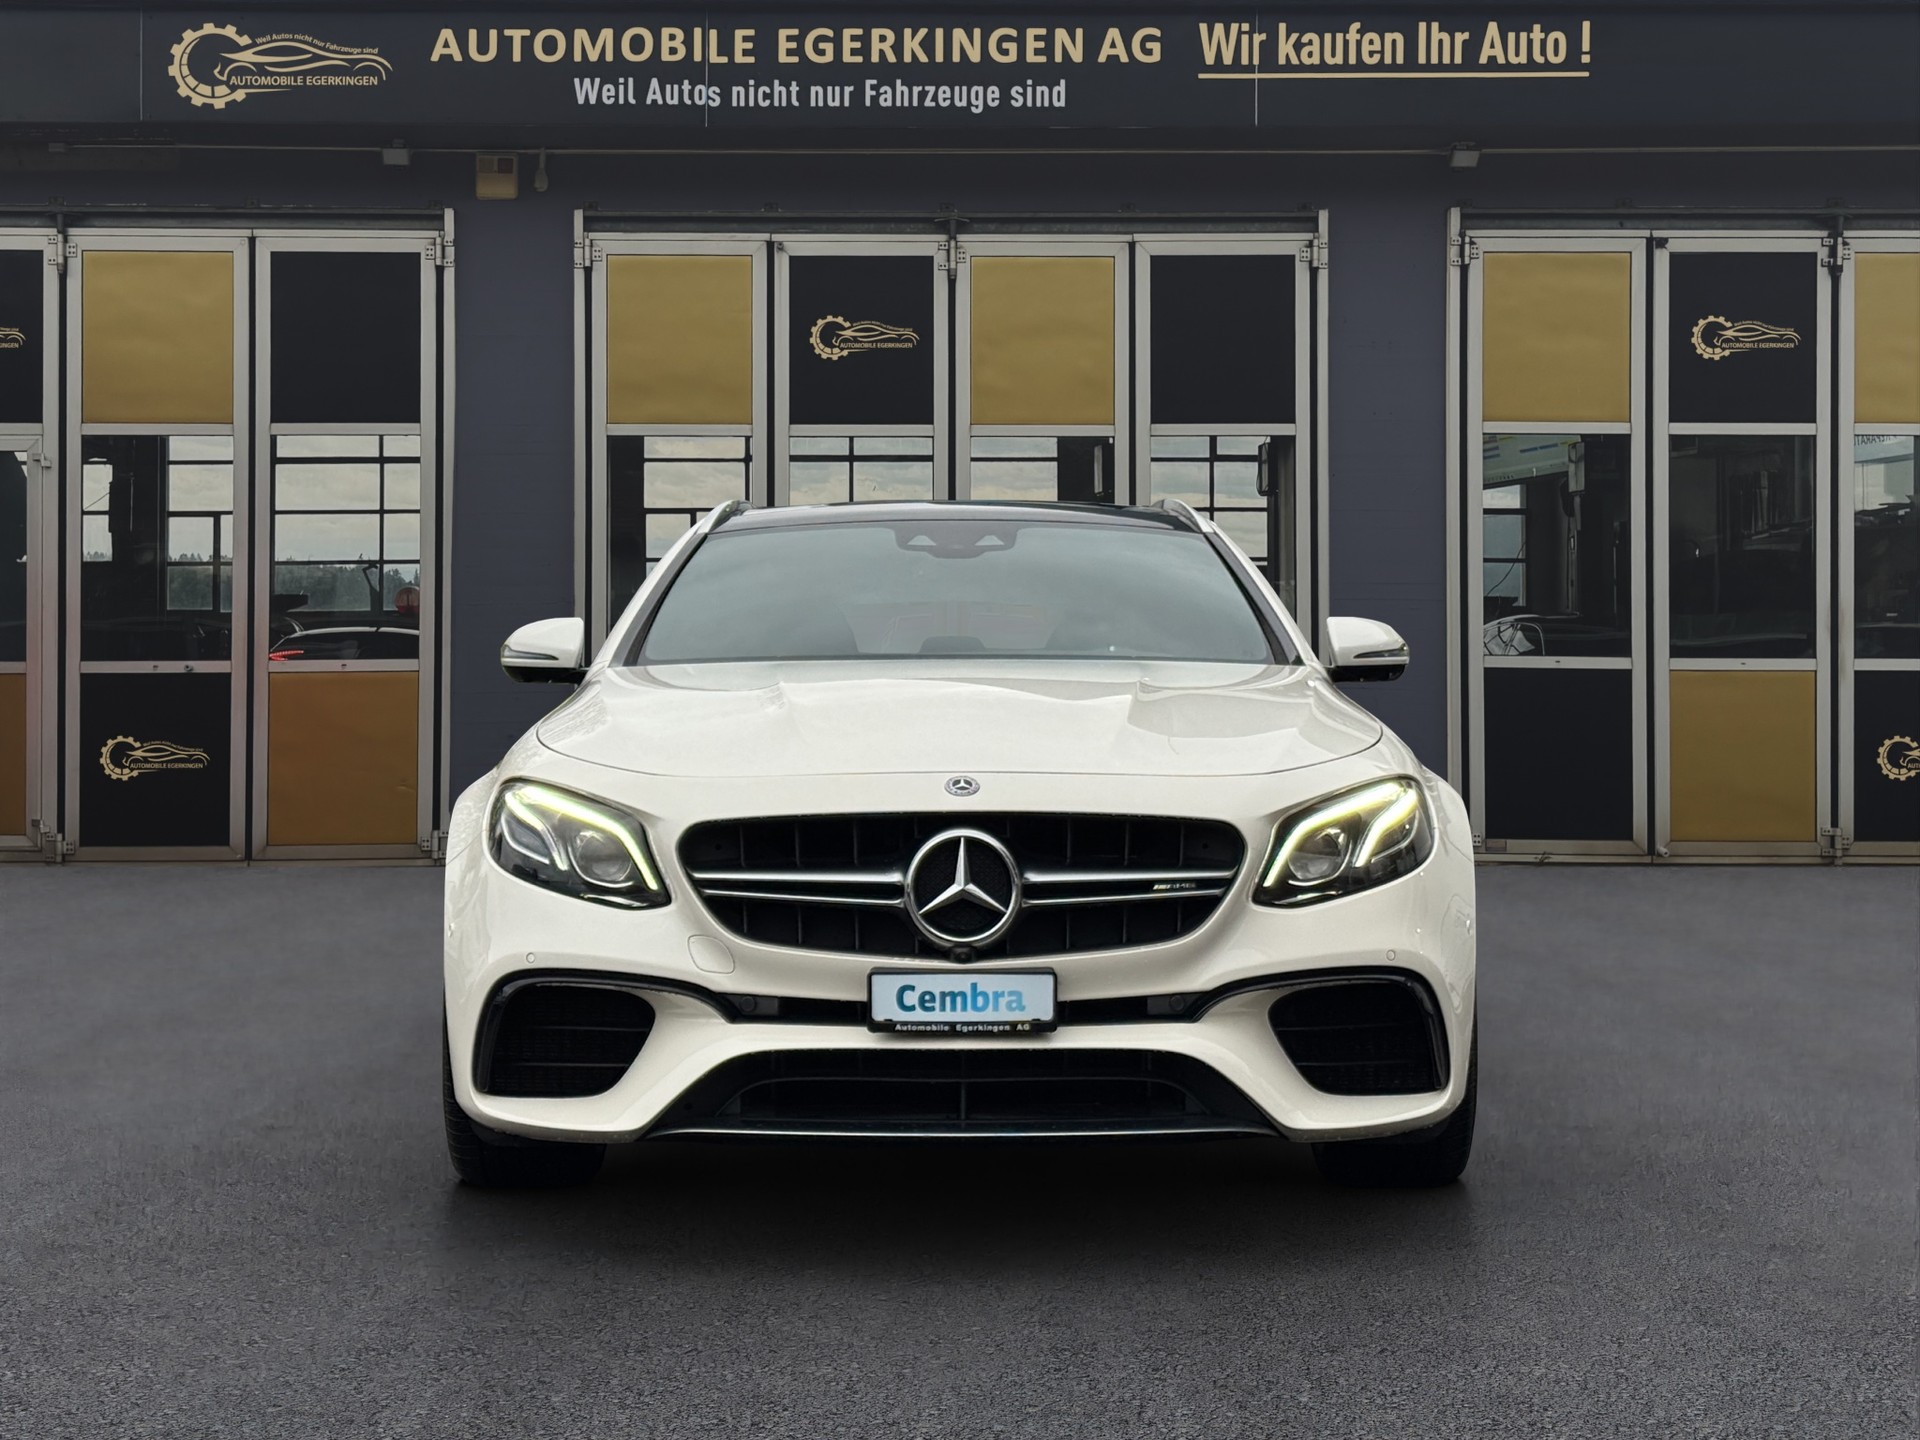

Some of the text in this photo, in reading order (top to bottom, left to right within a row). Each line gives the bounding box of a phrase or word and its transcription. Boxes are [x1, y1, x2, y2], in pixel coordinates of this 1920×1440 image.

[255, 35, 271, 45] Weil
[272, 33, 293, 41] Autos
[294, 34, 313, 43] nicht
[313, 39, 325, 47] nur
[325, 42, 362, 54] Fahrzeuge
[430, 27, 1161, 63] AUTOMOBILE EGERKINGEN AG
[1199, 21, 1590, 65] Wir kaufen Ihr Auto !
[230, 76, 377, 85] AUTOMOBILE EGERKINGEN
[574, 77, 1065, 113] Weil Autos nicht nur Fahrzeuge sind
[895, 982, 1026, 1013] Cembra
[894, 1024, 950, 1032] Automobile
[955, 1024, 1011, 1033] Egerkingen
